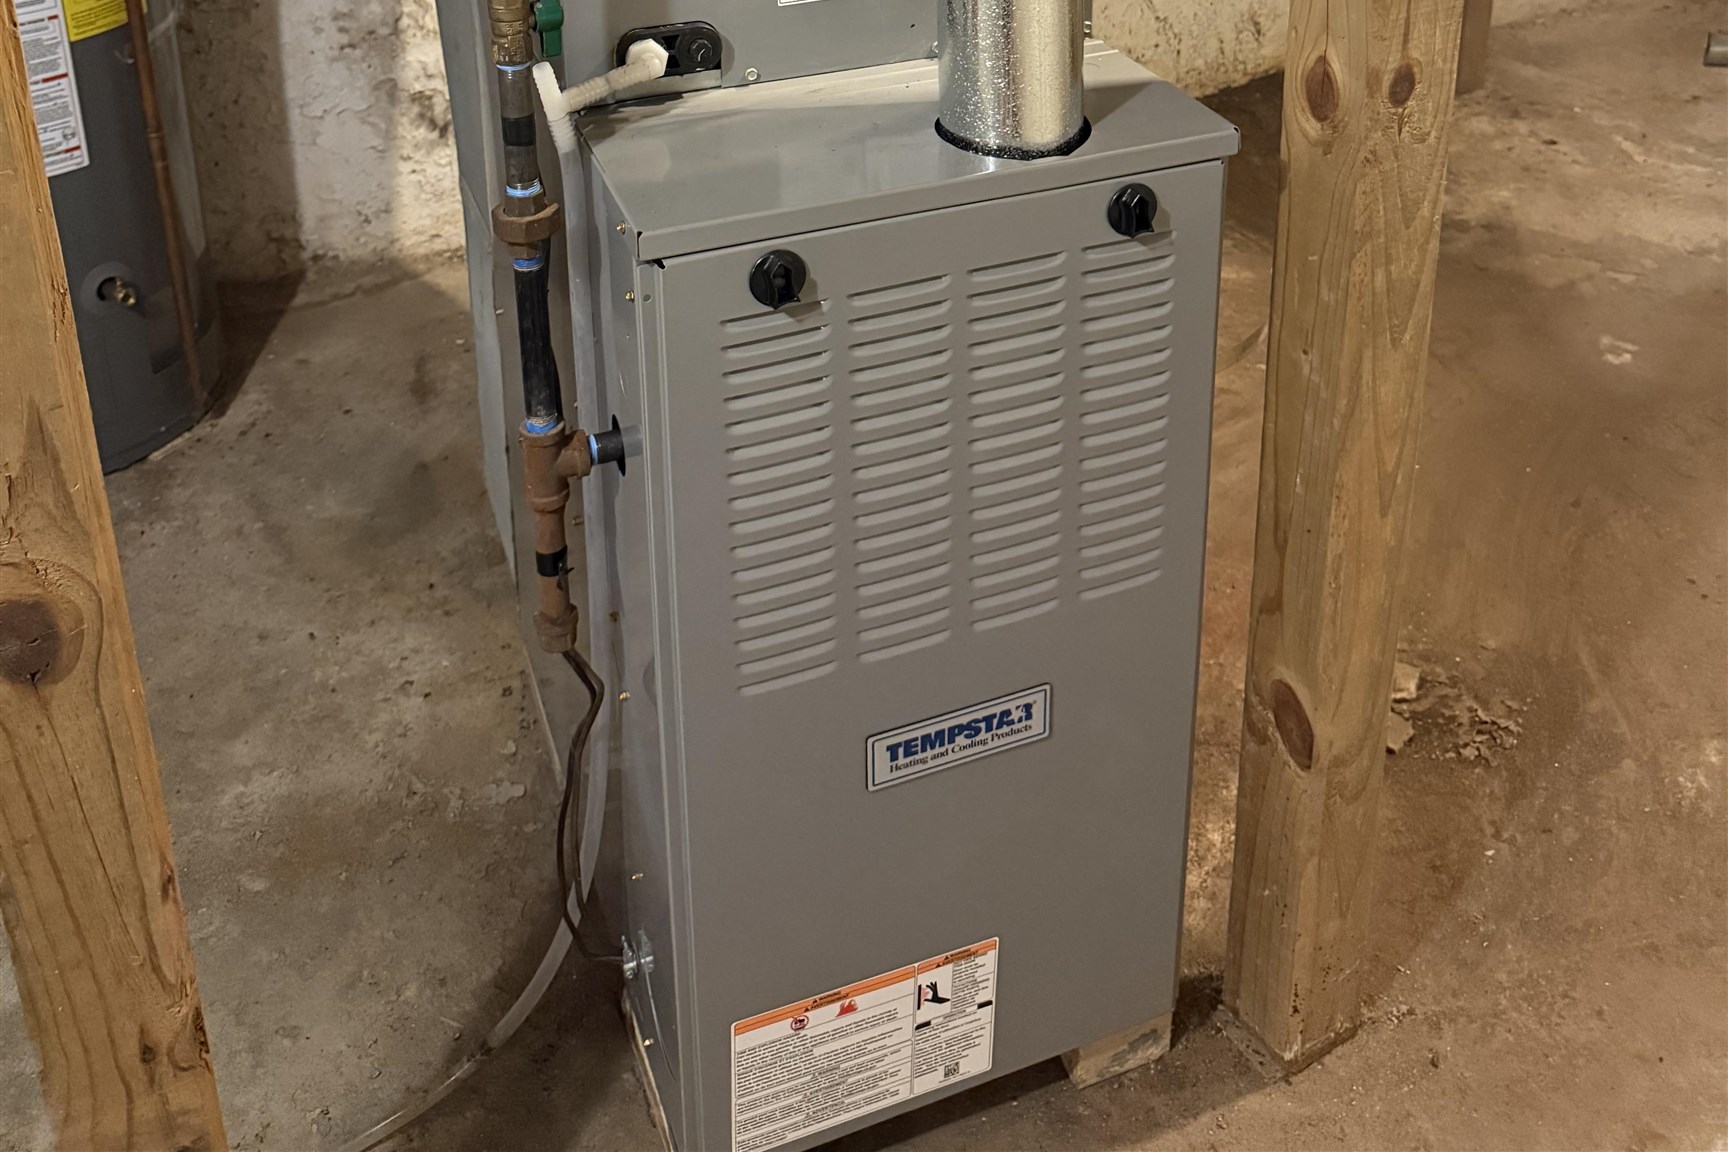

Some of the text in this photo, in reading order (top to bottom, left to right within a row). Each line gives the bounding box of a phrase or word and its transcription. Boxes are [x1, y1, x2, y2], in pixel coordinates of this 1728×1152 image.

[886, 702, 1033, 762] TEMPSTAR
[890, 723, 1032, 773] Heating and Cooling Products
